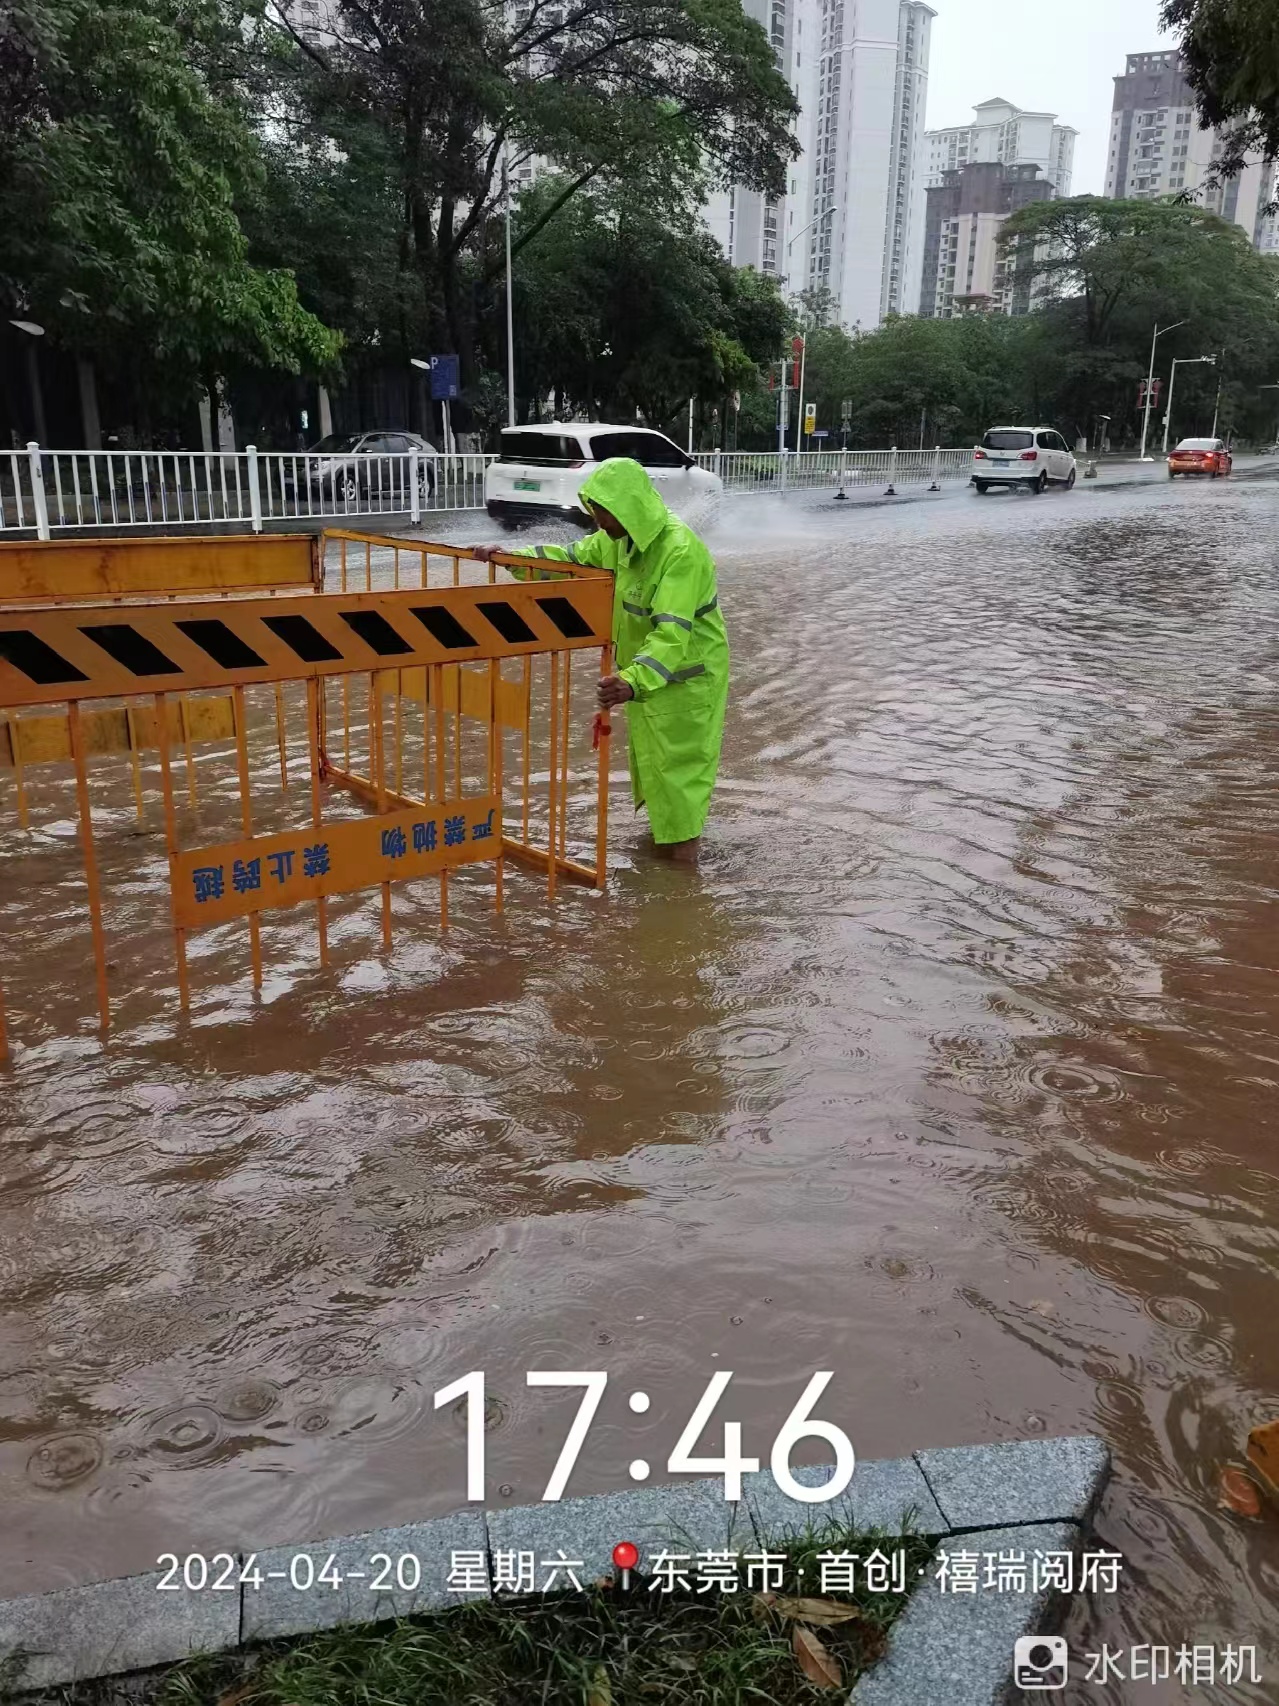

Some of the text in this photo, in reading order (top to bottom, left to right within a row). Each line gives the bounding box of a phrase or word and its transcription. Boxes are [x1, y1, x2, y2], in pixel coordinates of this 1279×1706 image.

[431, 357, 438, 369] P
[192, 808, 495, 903] 严禁抛物 禁止跨越
